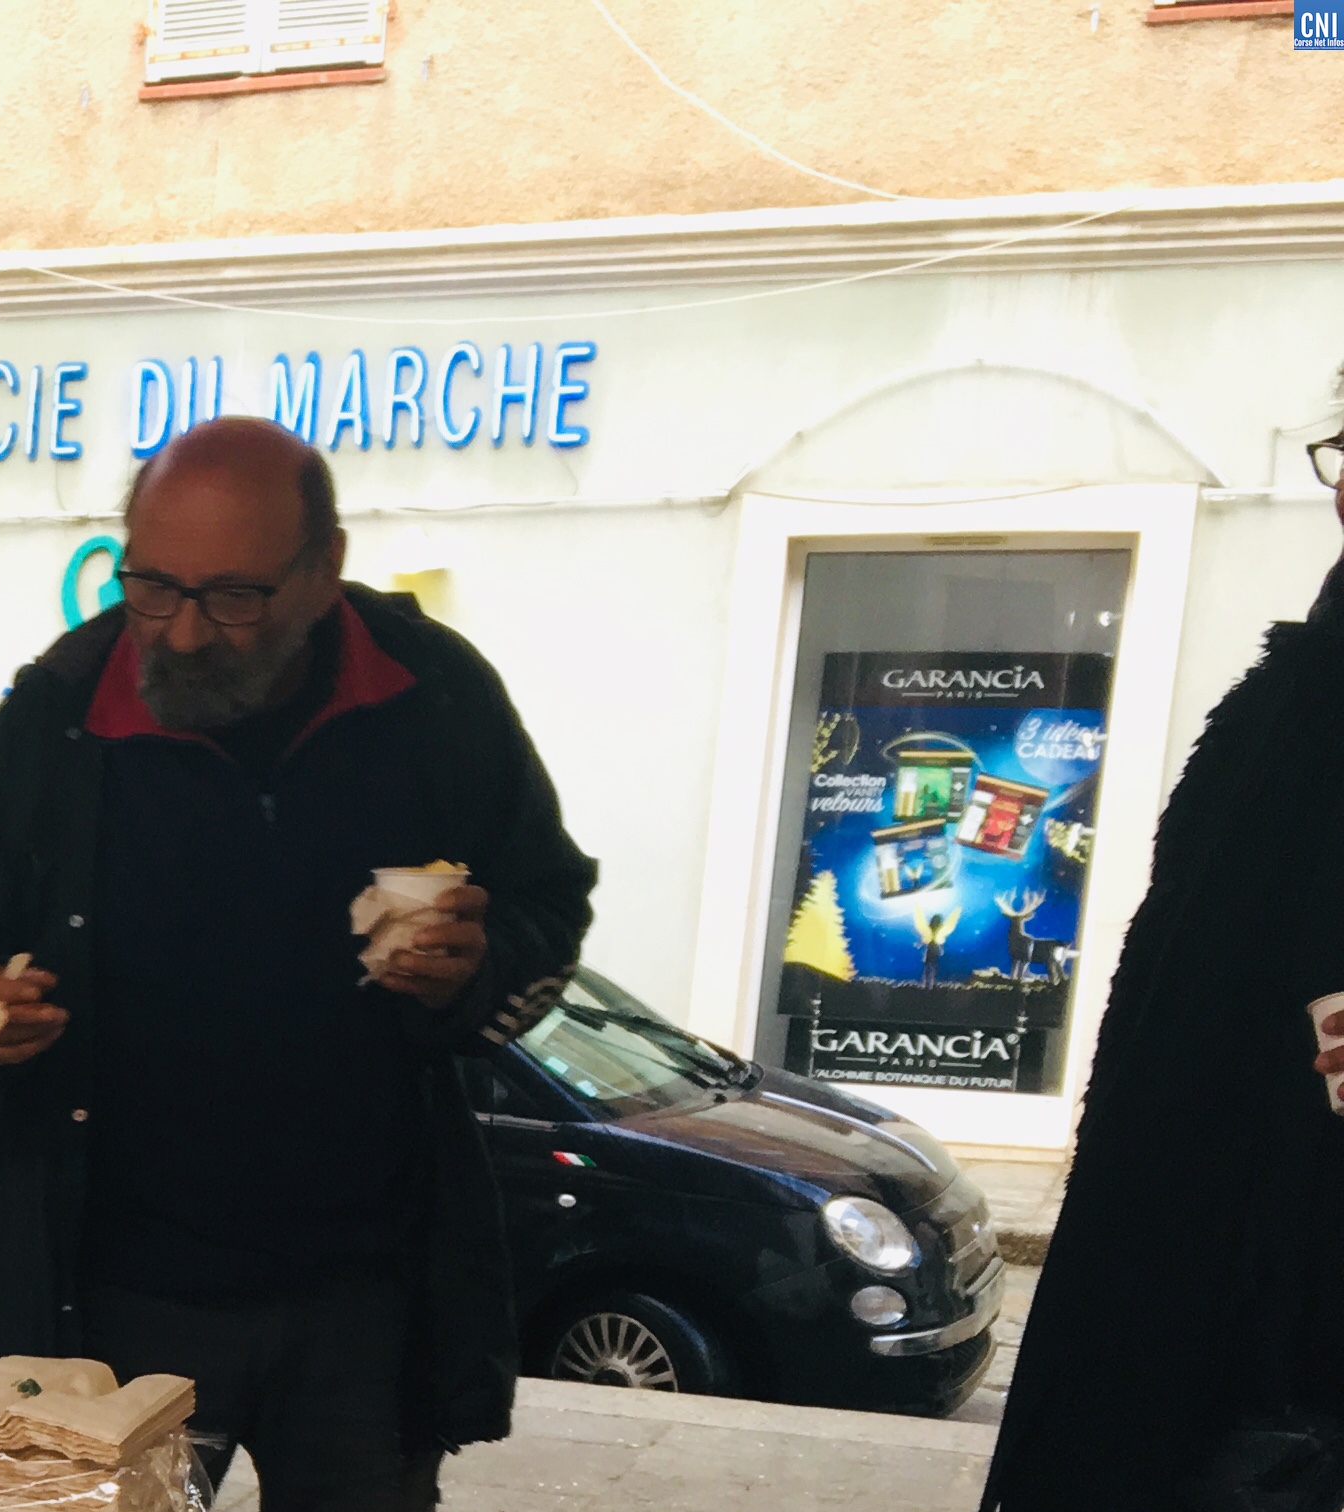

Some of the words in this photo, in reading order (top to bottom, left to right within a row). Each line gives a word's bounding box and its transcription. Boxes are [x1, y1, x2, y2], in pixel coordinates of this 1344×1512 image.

[128, 356, 223, 459] DU
[269, 341, 597, 451] MARCHE
[813, 774, 887, 788] Collection
[811, 792, 885, 813] velours
[878, 1057, 939, 1069] PARIS
